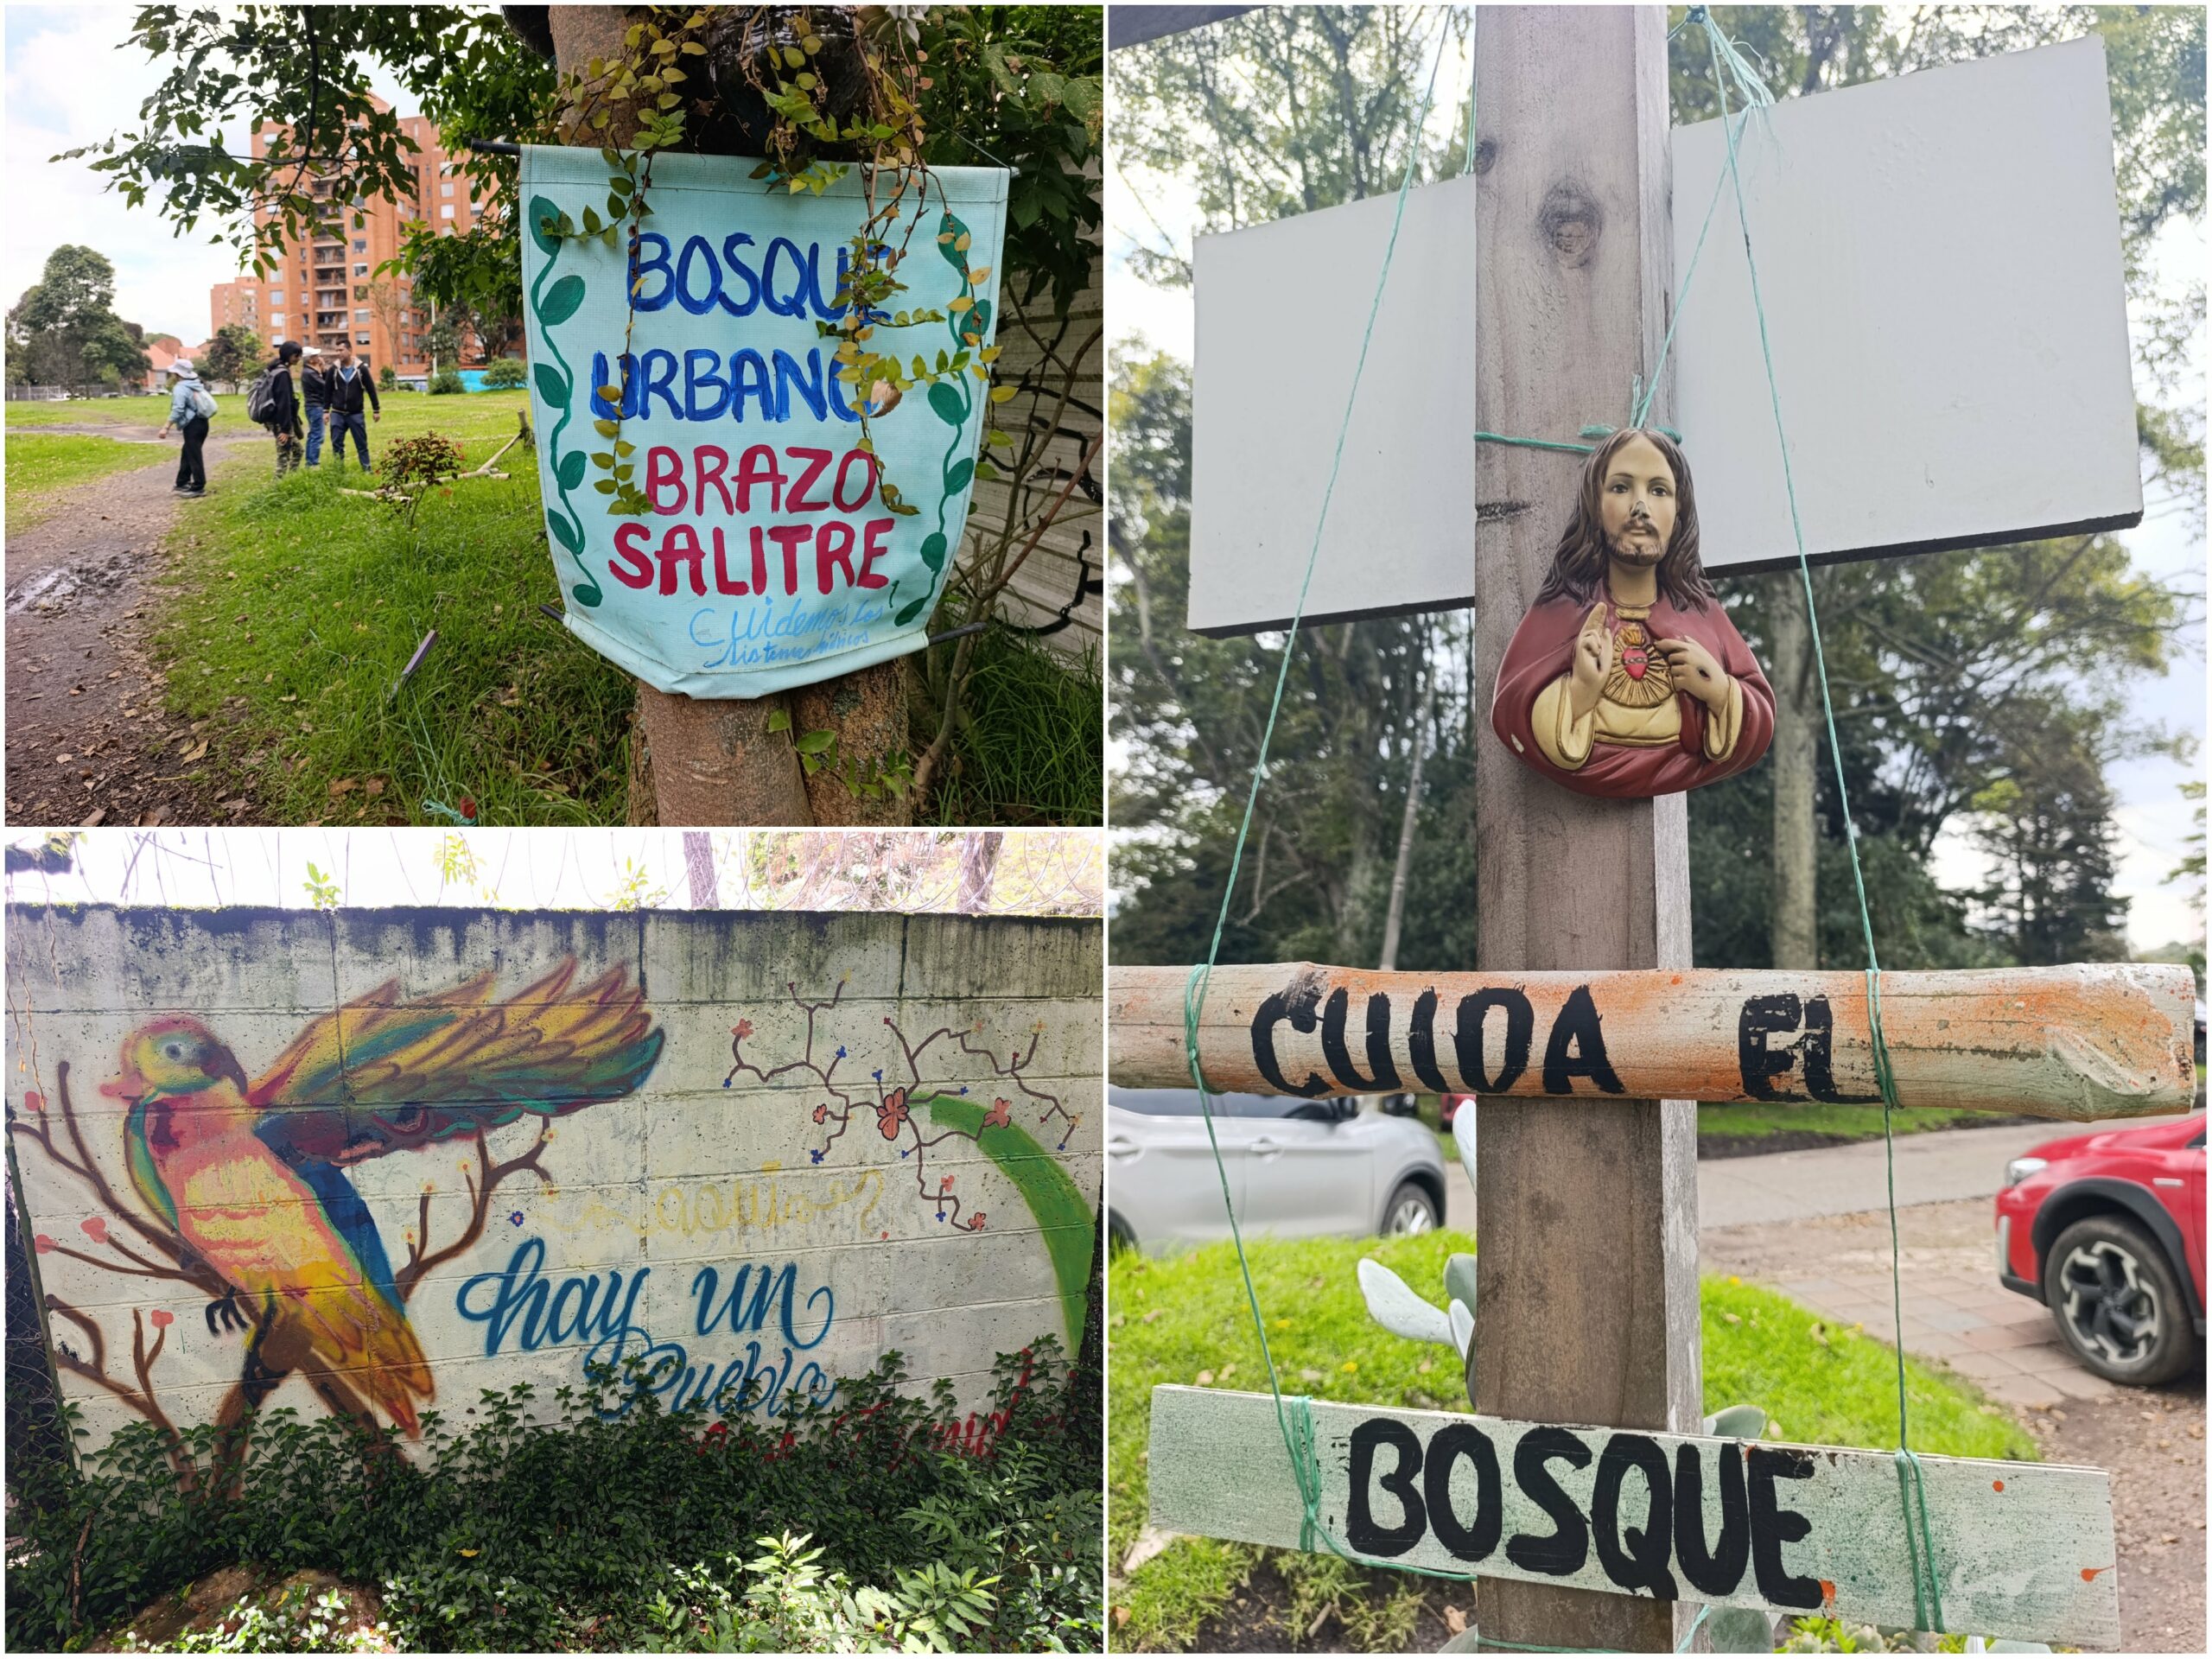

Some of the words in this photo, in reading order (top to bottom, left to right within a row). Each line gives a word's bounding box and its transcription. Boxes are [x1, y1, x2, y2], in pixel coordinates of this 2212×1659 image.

[645, 443, 877, 515] BRAZO
[608, 518, 894, 596] SALITRE
[1737, 993, 1888, 1103] EL
[456, 1236, 652, 1374] hay
[692, 1262, 835, 1350] un
[1345, 1417, 1825, 1610] BOSQUE
